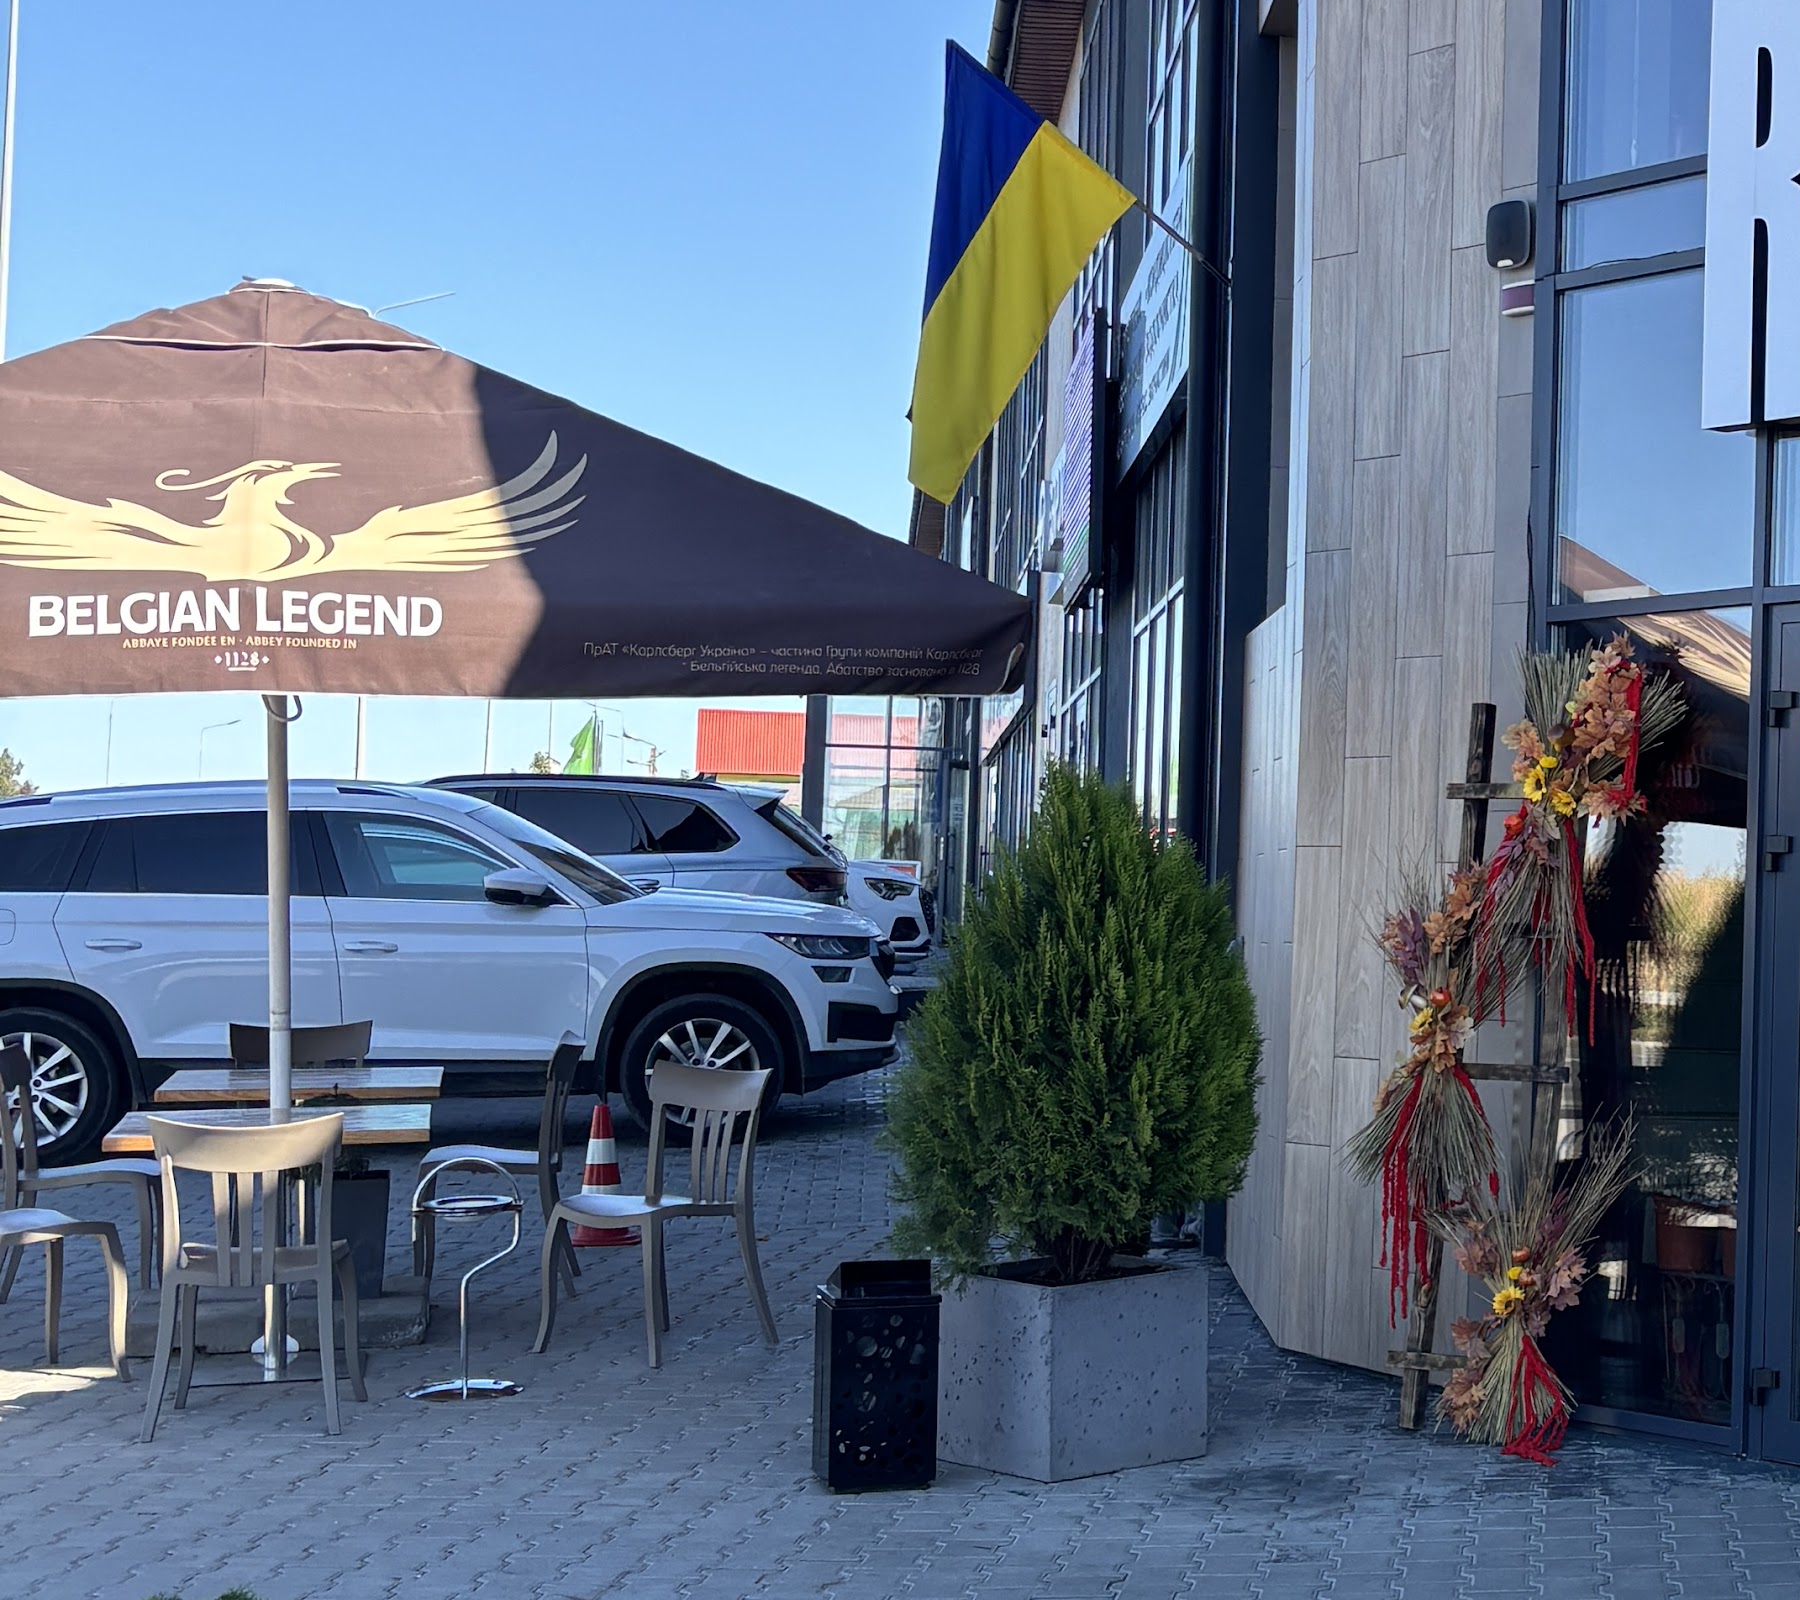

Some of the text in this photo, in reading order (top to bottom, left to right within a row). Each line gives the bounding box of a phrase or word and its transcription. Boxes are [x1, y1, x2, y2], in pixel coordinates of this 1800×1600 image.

[28, 585, 444, 638] BELGIAN LEGEND
[122, 636, 169, 649] ABBAYE
[220, 635, 236, 647] EN
[245, 635, 283, 648] ABBEY
[285, 636, 341, 649] FOUNDED
[342, 638, 358, 649] IN
[583, 641, 619, 657] ПрАТ
[621, 644, 696, 658] «Карлсберг
[699, 644, 756, 658] Україна»
[770, 646, 823, 658] частина
[825, 645, 862, 660] Групи
[865, 646, 923, 659] компаній
[224, 651, 260, 667] 1128
[690, 659, 767, 674] Бельгійська
[825, 661, 884, 677] Абатство
